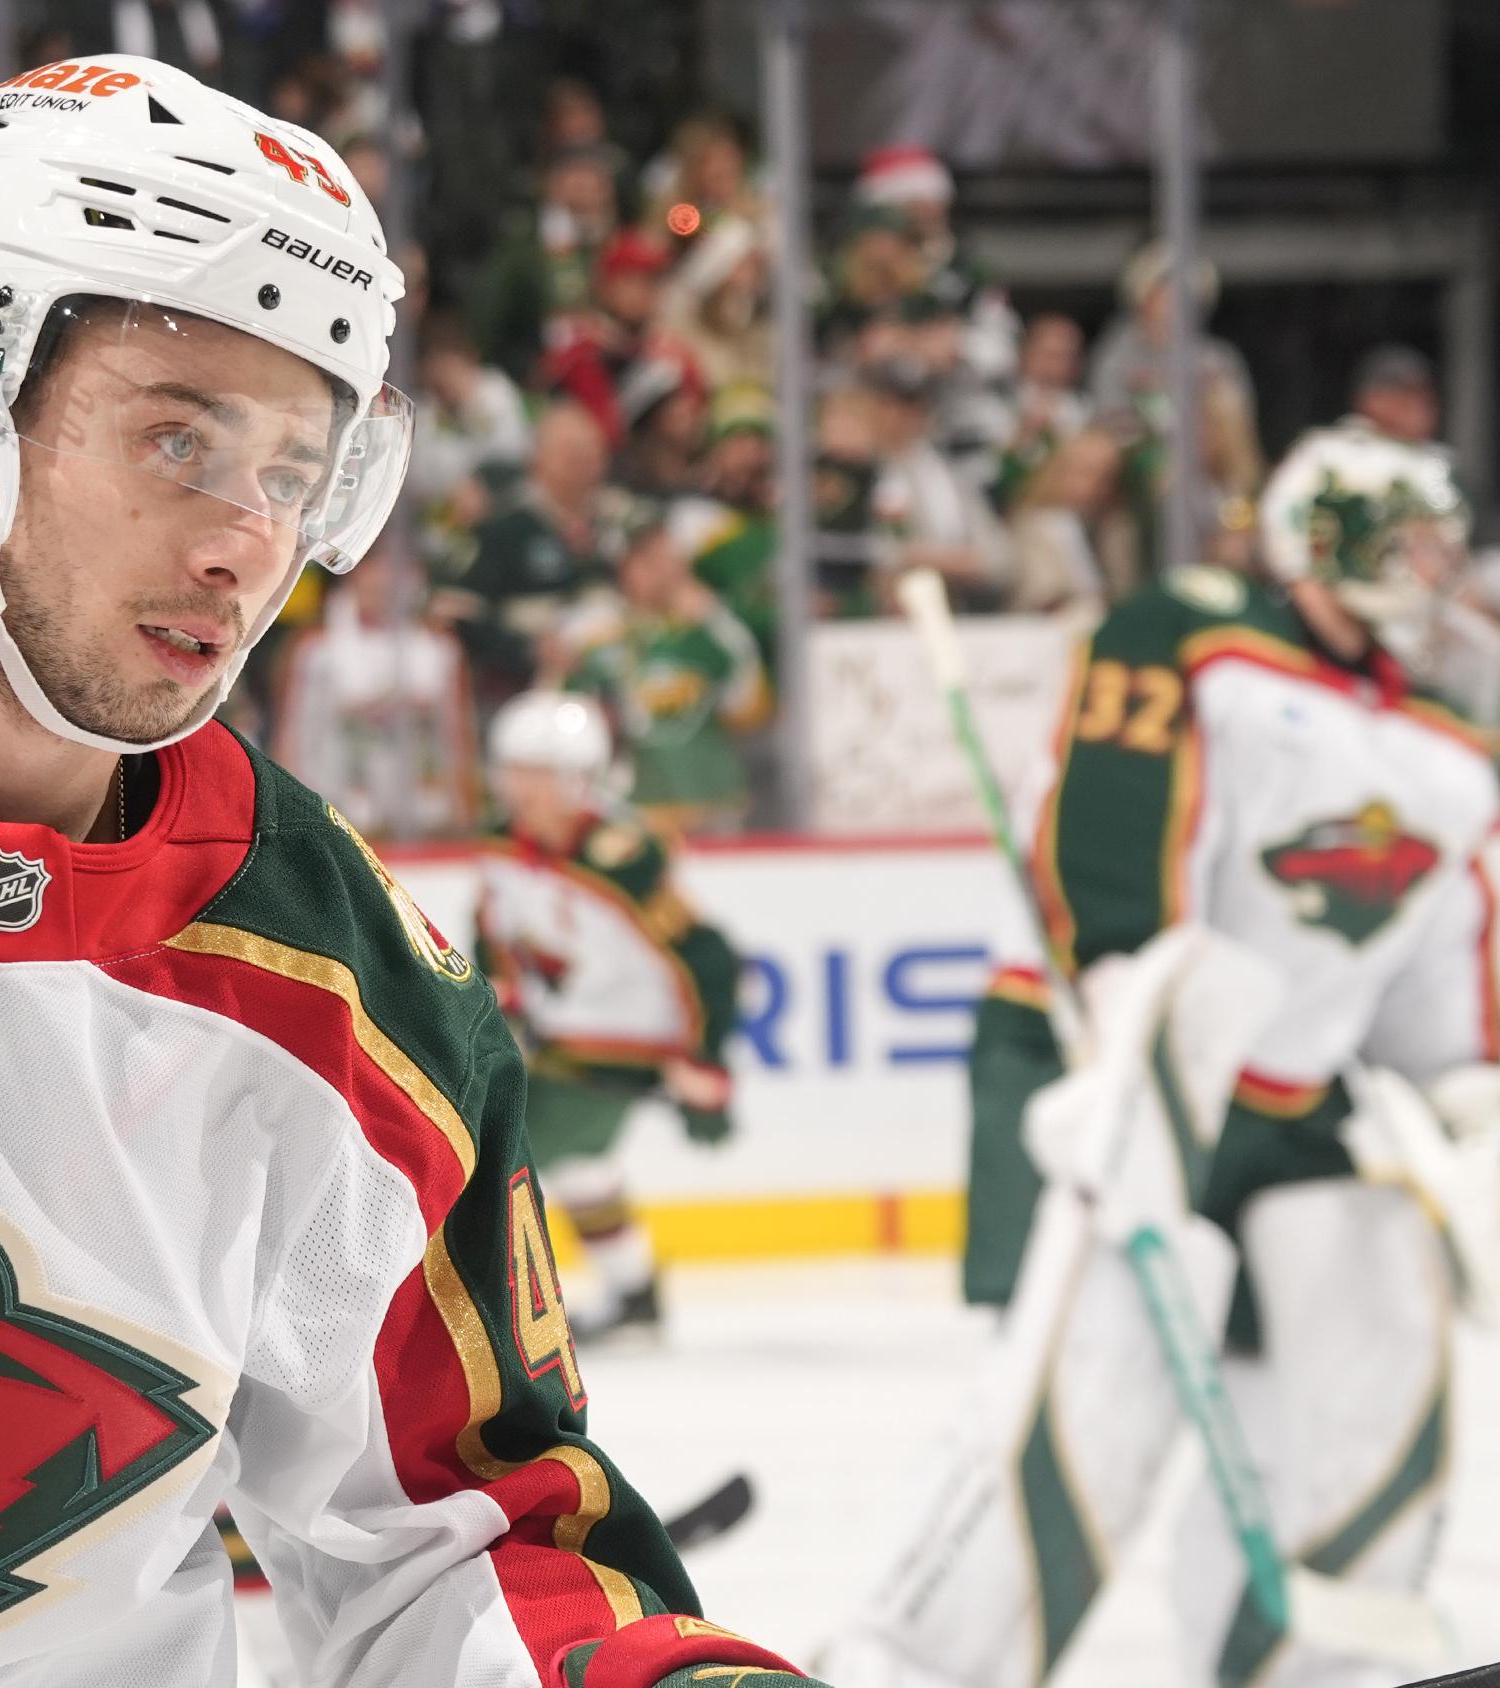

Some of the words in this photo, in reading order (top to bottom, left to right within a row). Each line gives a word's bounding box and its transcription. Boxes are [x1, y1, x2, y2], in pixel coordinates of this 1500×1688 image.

[32, 97, 92, 113] UNION
[253, 131, 351, 208] 43
[1074, 659, 1184, 755] 32
